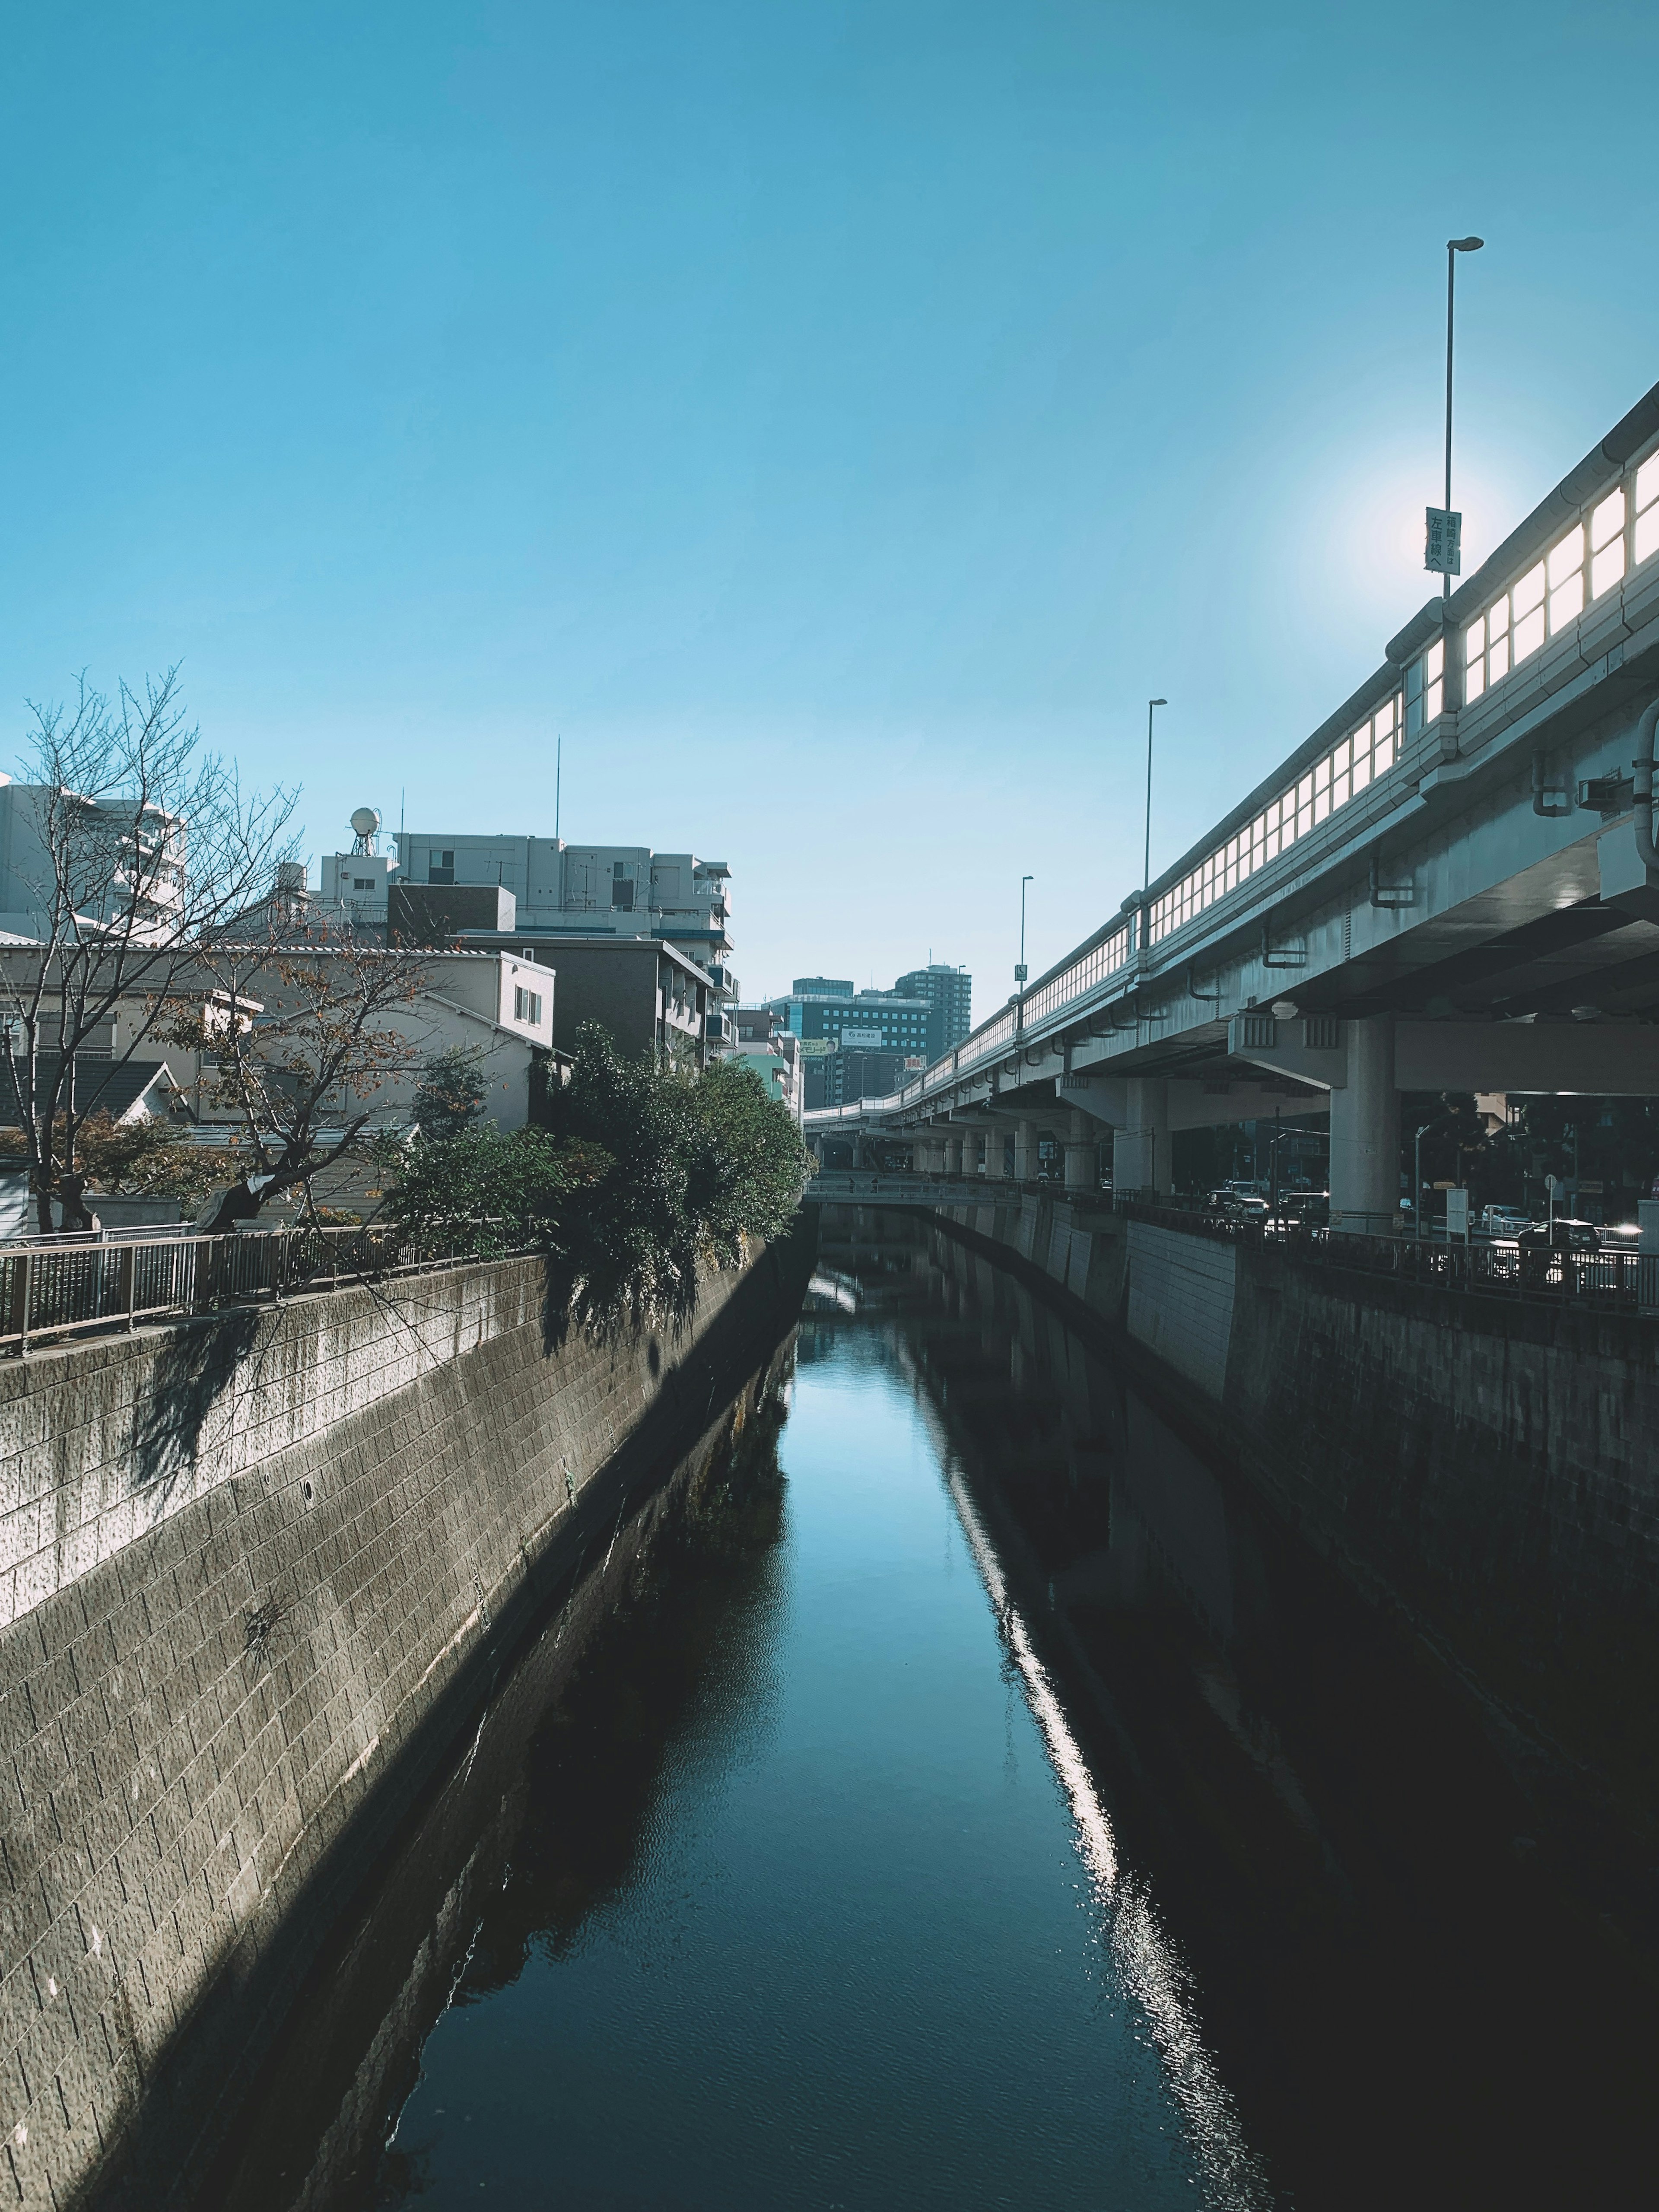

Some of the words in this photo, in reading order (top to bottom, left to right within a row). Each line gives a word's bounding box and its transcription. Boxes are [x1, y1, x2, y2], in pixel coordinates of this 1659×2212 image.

[1431, 516, 1442, 566] 左車線へ
[1446, 516, 1456, 565] 箱崎方面は
